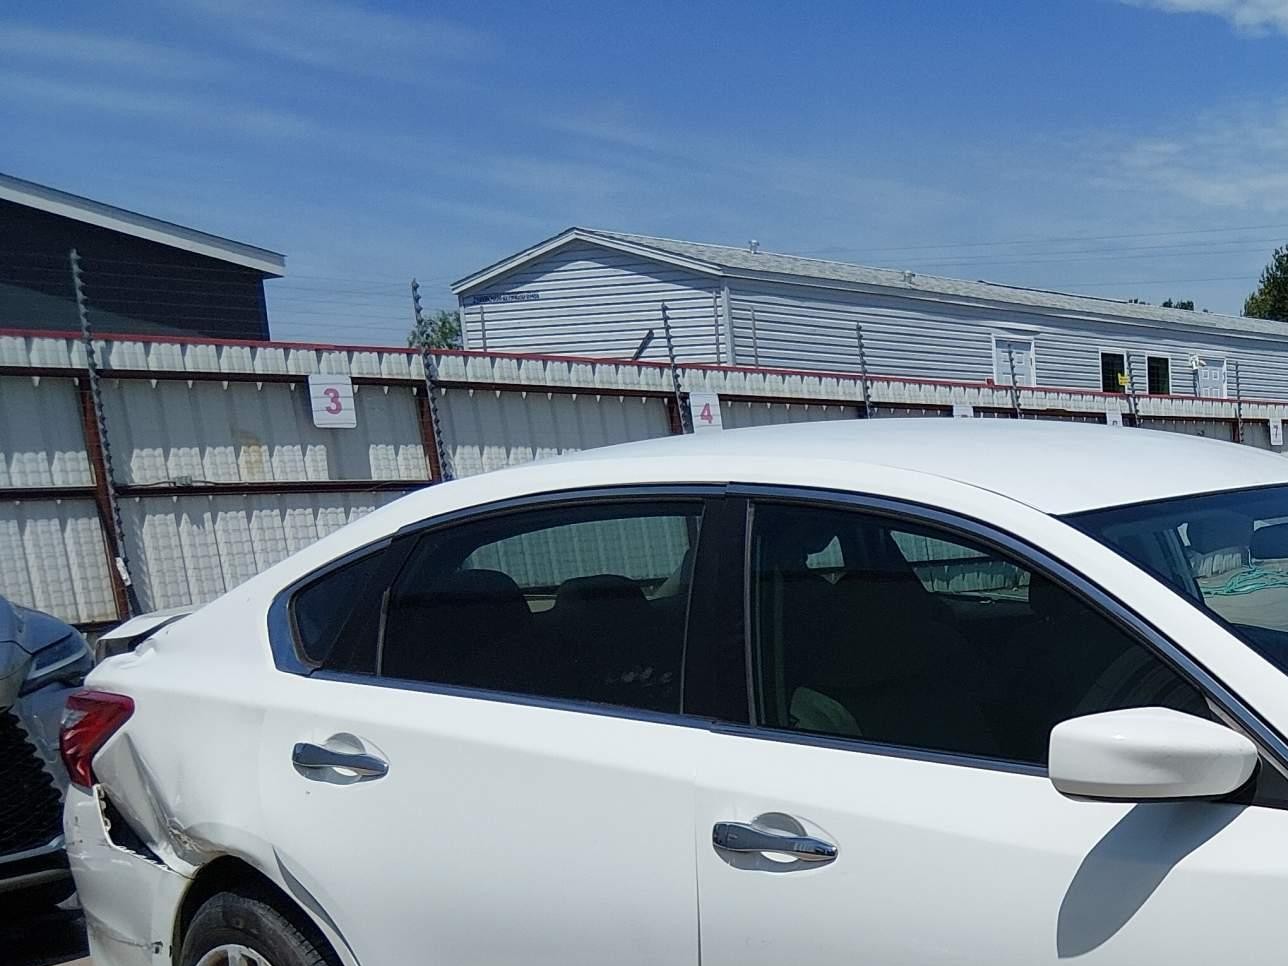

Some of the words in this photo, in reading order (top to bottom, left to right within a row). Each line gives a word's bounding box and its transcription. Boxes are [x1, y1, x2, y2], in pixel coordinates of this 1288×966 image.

[323, 388, 342, 415] 3
[700, 402, 713, 424] 4
[1273, 424, 1279, 439] 7
